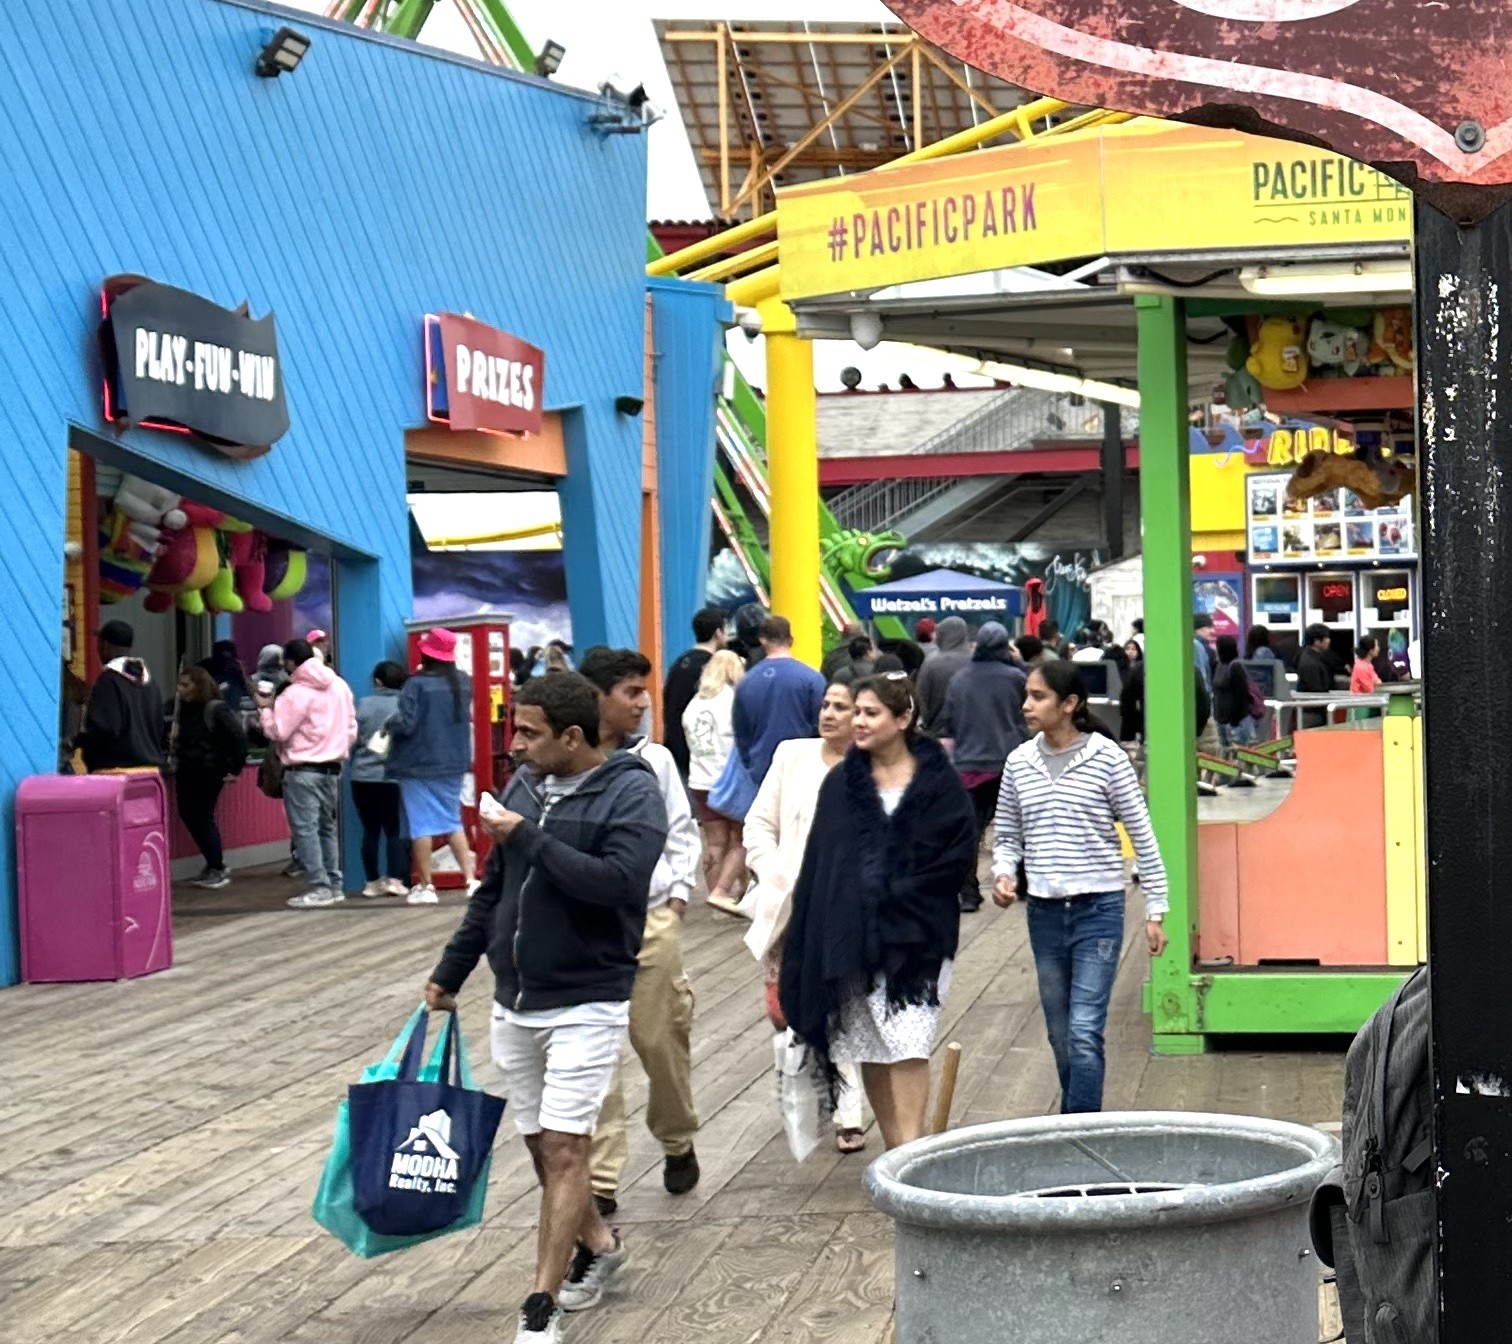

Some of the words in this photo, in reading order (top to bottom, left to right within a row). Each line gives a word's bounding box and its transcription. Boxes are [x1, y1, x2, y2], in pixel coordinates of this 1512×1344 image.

[1253, 158, 1365, 201] PACIFIC
[828, 182, 1037, 262] #PACIFICPARK
[1309, 209, 1362, 226] SANTA
[1373, 207, 1407, 223] MON
[456, 343, 534, 412] PRIZES
[870, 597, 937, 612] Wetzel's
[940, 596, 1007, 612] Pretzels
[390, 1152, 458, 1180] MODHA
[388, 1173, 432, 1194] Realty,
[434, 1178, 457, 1194] Inc.
